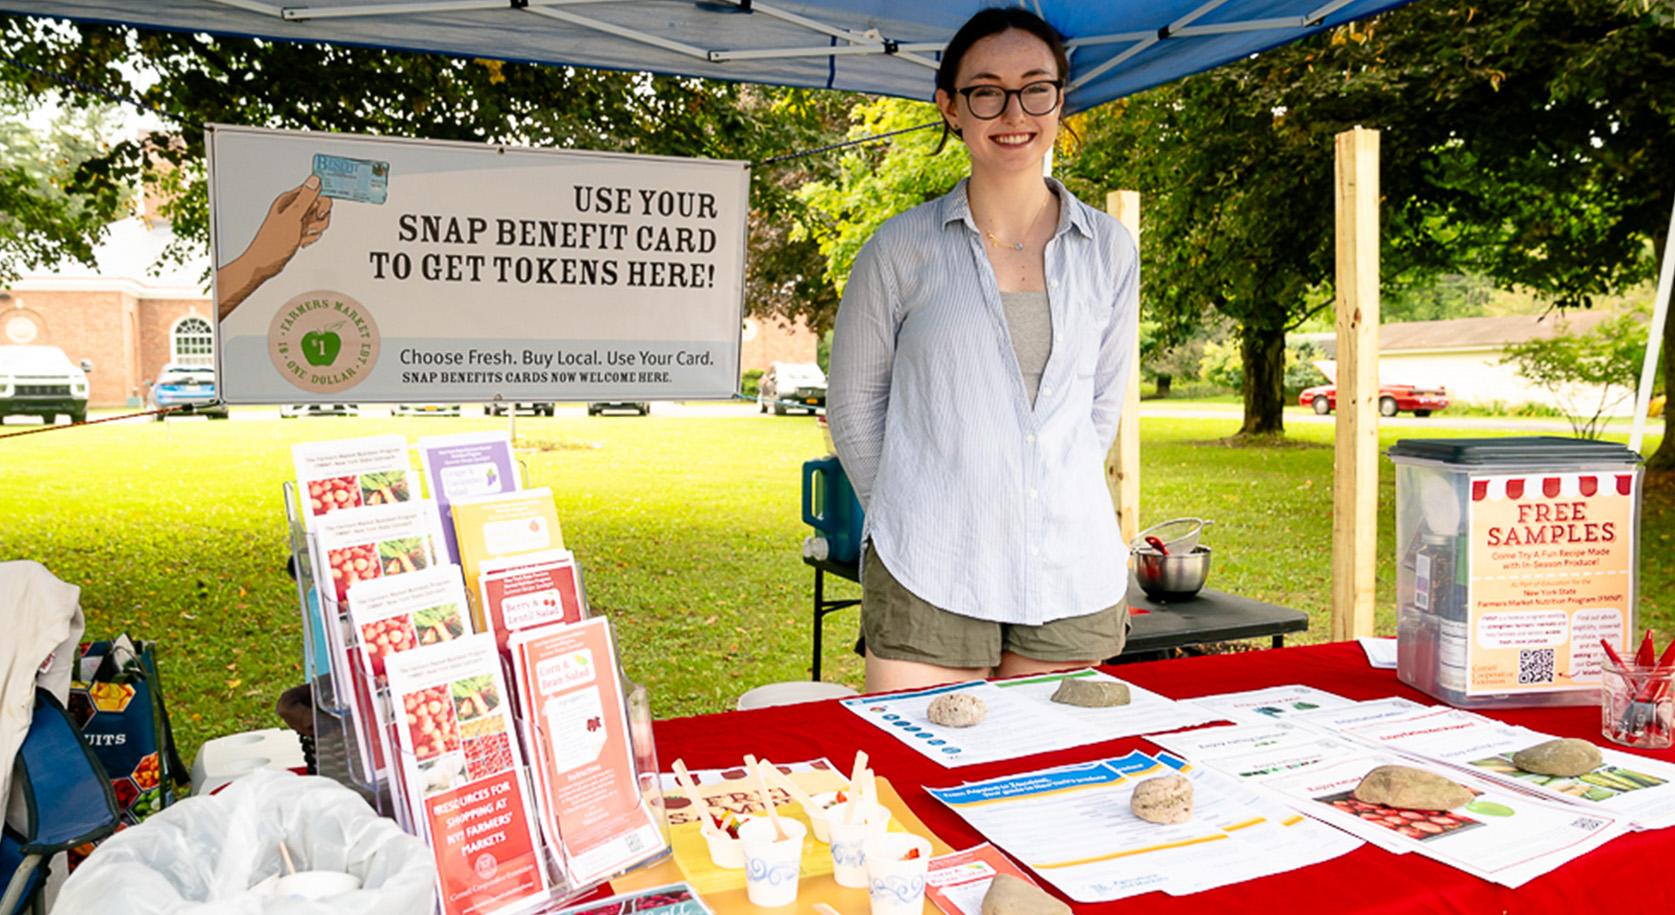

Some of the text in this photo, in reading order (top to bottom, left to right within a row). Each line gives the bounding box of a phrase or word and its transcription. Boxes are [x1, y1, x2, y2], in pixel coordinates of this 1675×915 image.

[573, 185, 717, 219] USE YOUR
[398, 214, 717, 253] SNAP BENEFIT CARD
[369, 251, 715, 288] TO GET TOKENS HERE!
[280, 299, 371, 365] FARMERS MARKET EBT
[400, 349, 714, 369] Choose Fresh. Buy Local. Use Your Card.
[286, 360, 356, 384] ONE DOLLAR
[401, 371, 673, 384] SNAP BENEFITS CARDS NOW WELCOME HERE.
[1517, 502, 1587, 523] FREE
[1487, 522, 1615, 546] SAMPLES
[1491, 547, 1610, 561] Come Try A Fun Recipe Made
[1502, 558, 1600, 569] with In-Season Produce!
[1477, 600, 1507, 608] Farmers
[1508, 599, 1533, 607] Market
[1535, 598, 1566, 606] Nutrition
[1567, 596, 1596, 606] Program
[1523, 588, 1577, 597] New York State
[505, 599, 540, 613] Berry &
[535, 606, 560, 618] Salad
[539, 664, 561, 677] Corn
[541, 667, 590, 689] Bean Salad
[433, 781, 511, 816] RESOURCES FOR
[446, 798, 508, 829] SHOPPING AT
[465, 811, 512, 838] FARMERS'
[461, 831, 506, 857] MARKETS
